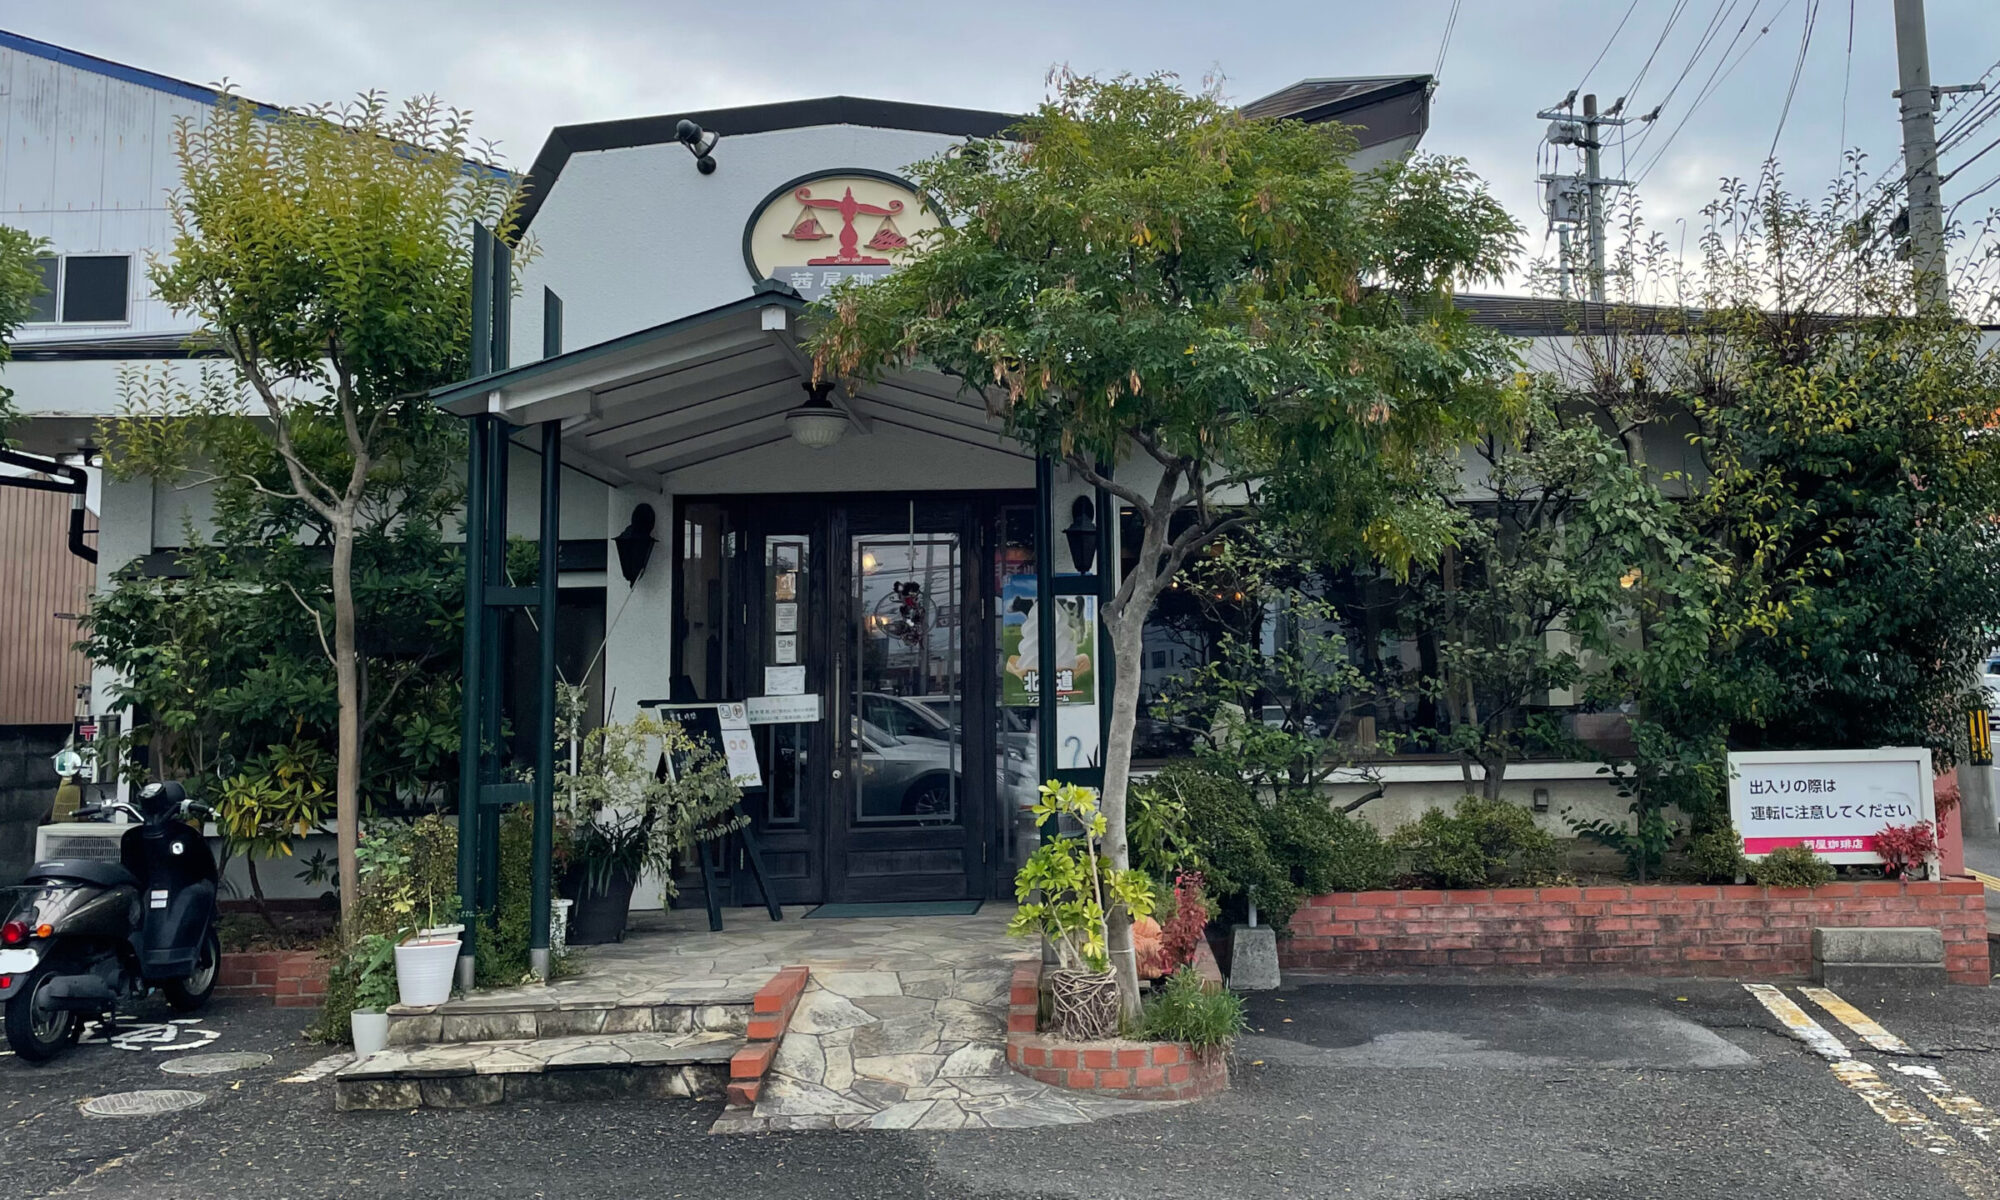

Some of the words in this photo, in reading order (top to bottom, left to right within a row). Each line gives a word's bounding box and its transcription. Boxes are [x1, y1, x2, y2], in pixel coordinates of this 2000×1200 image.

[1023, 670, 1073, 692] 北道
[1750, 779, 1836, 794] 出入りの際は
[1751, 803, 1912, 820] 運転に注意してください
